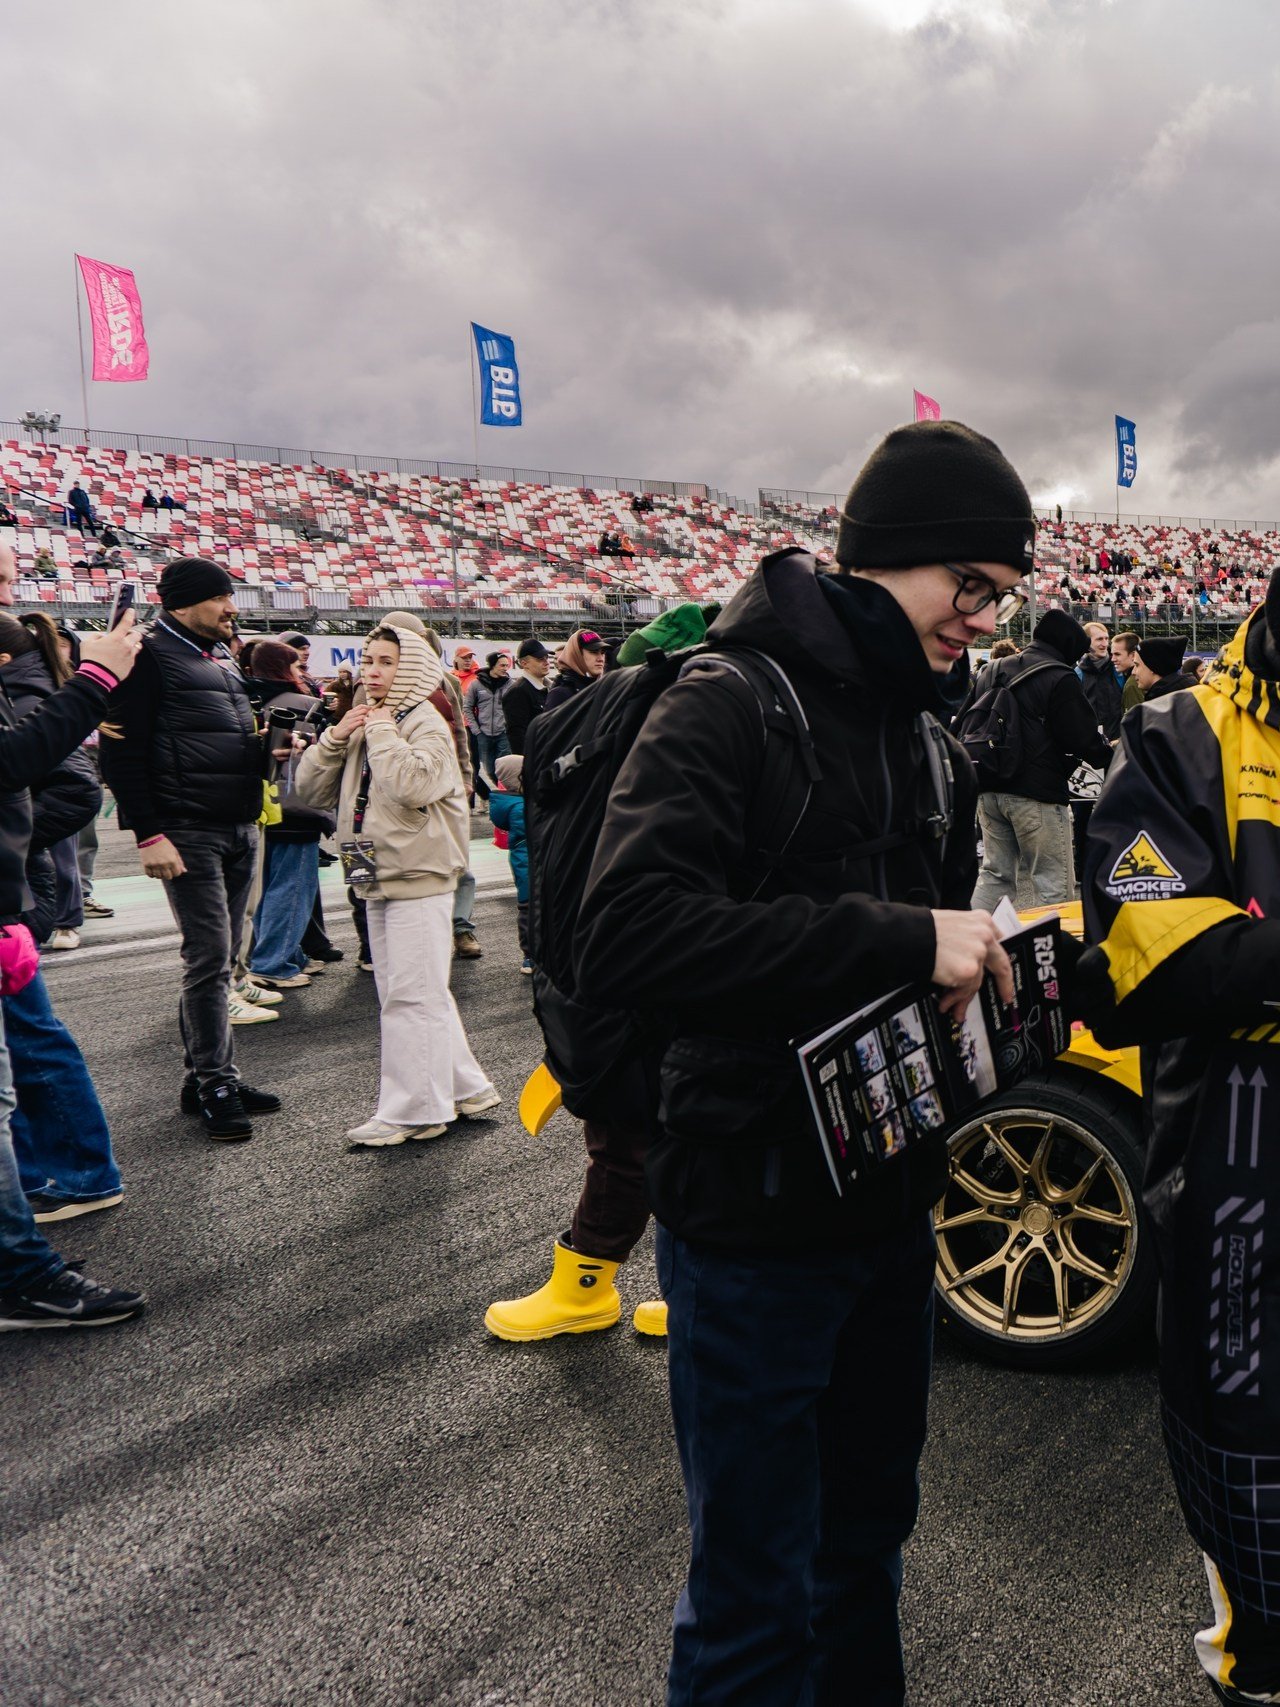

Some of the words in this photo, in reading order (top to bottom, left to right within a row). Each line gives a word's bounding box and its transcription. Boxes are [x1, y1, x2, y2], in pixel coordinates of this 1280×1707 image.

[1105, 881, 1187, 896] SMOKED
[1120, 891, 1171, 902] WHEELS
[1033, 934, 1057, 982] RDS
[1042, 980, 1060, 1000] TV
